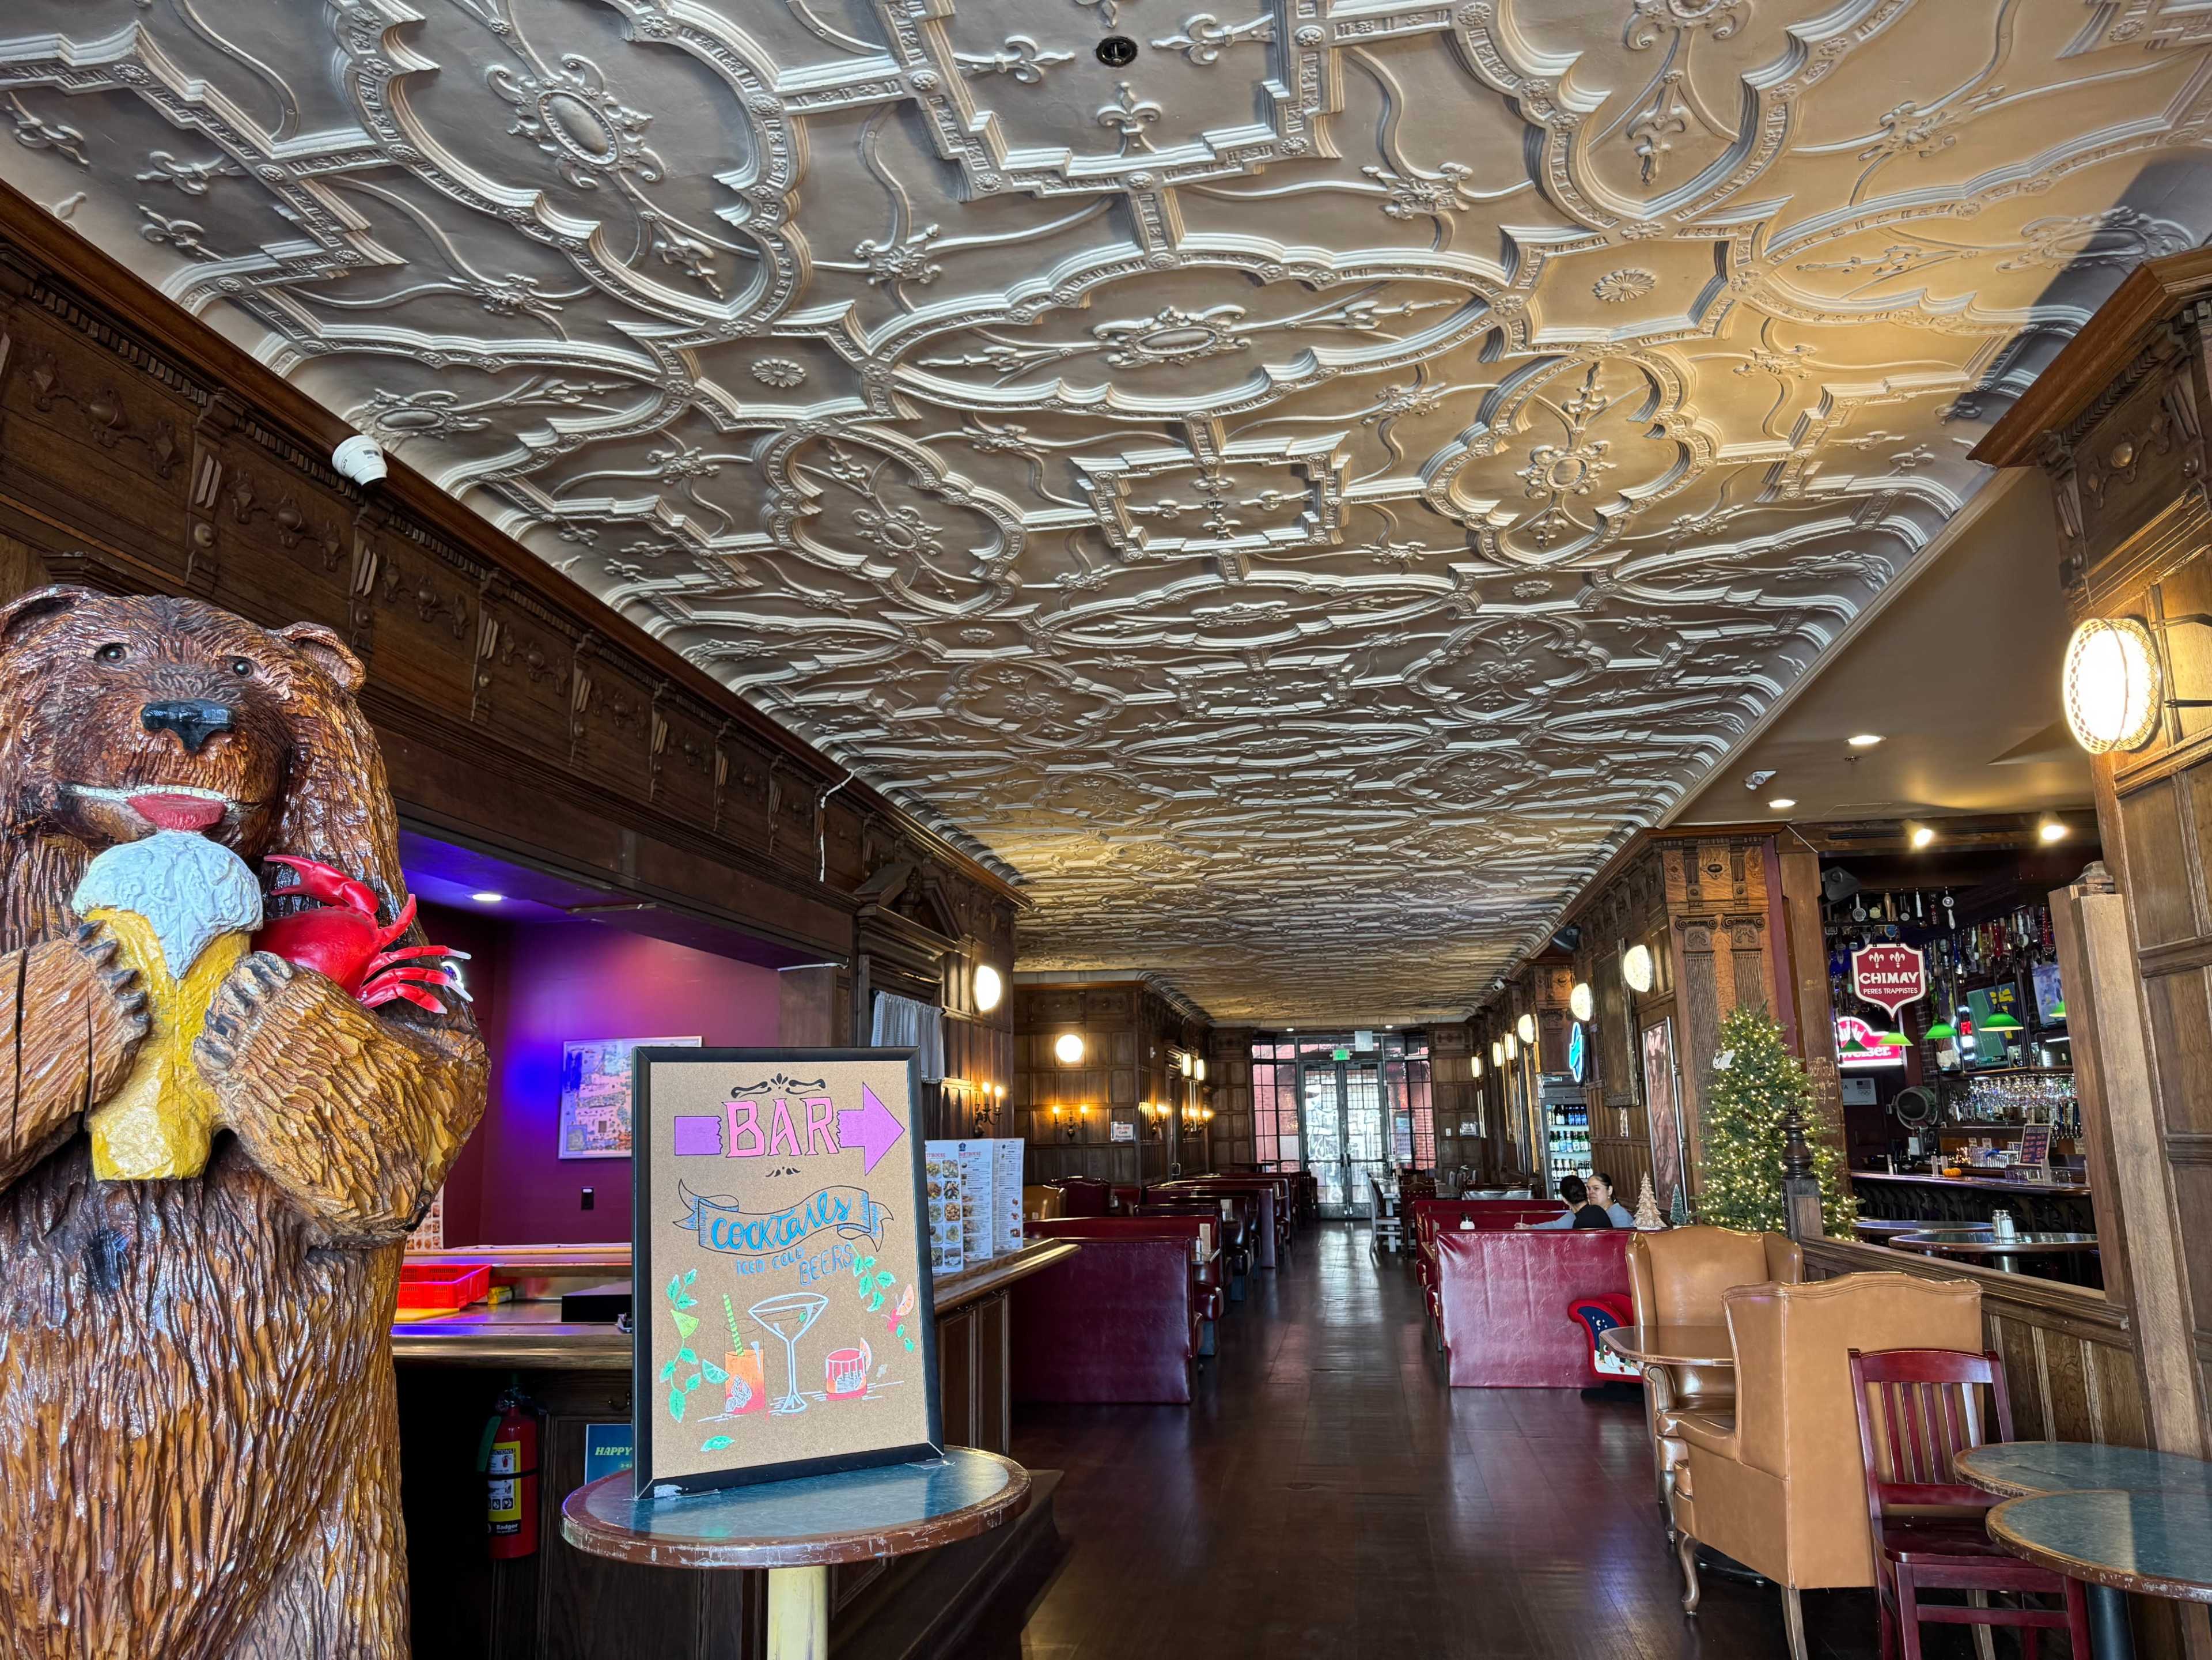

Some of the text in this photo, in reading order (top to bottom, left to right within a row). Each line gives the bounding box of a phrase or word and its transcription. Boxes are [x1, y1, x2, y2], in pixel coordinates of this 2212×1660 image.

[1859, 971, 1919, 985] CHIMAY
[722, 1097, 839, 1158] BAR
[772, 1246, 804, 1269] COLD
[799, 1243, 855, 1287] BEERS
[594, 1447, 632, 1456] HAPPY
